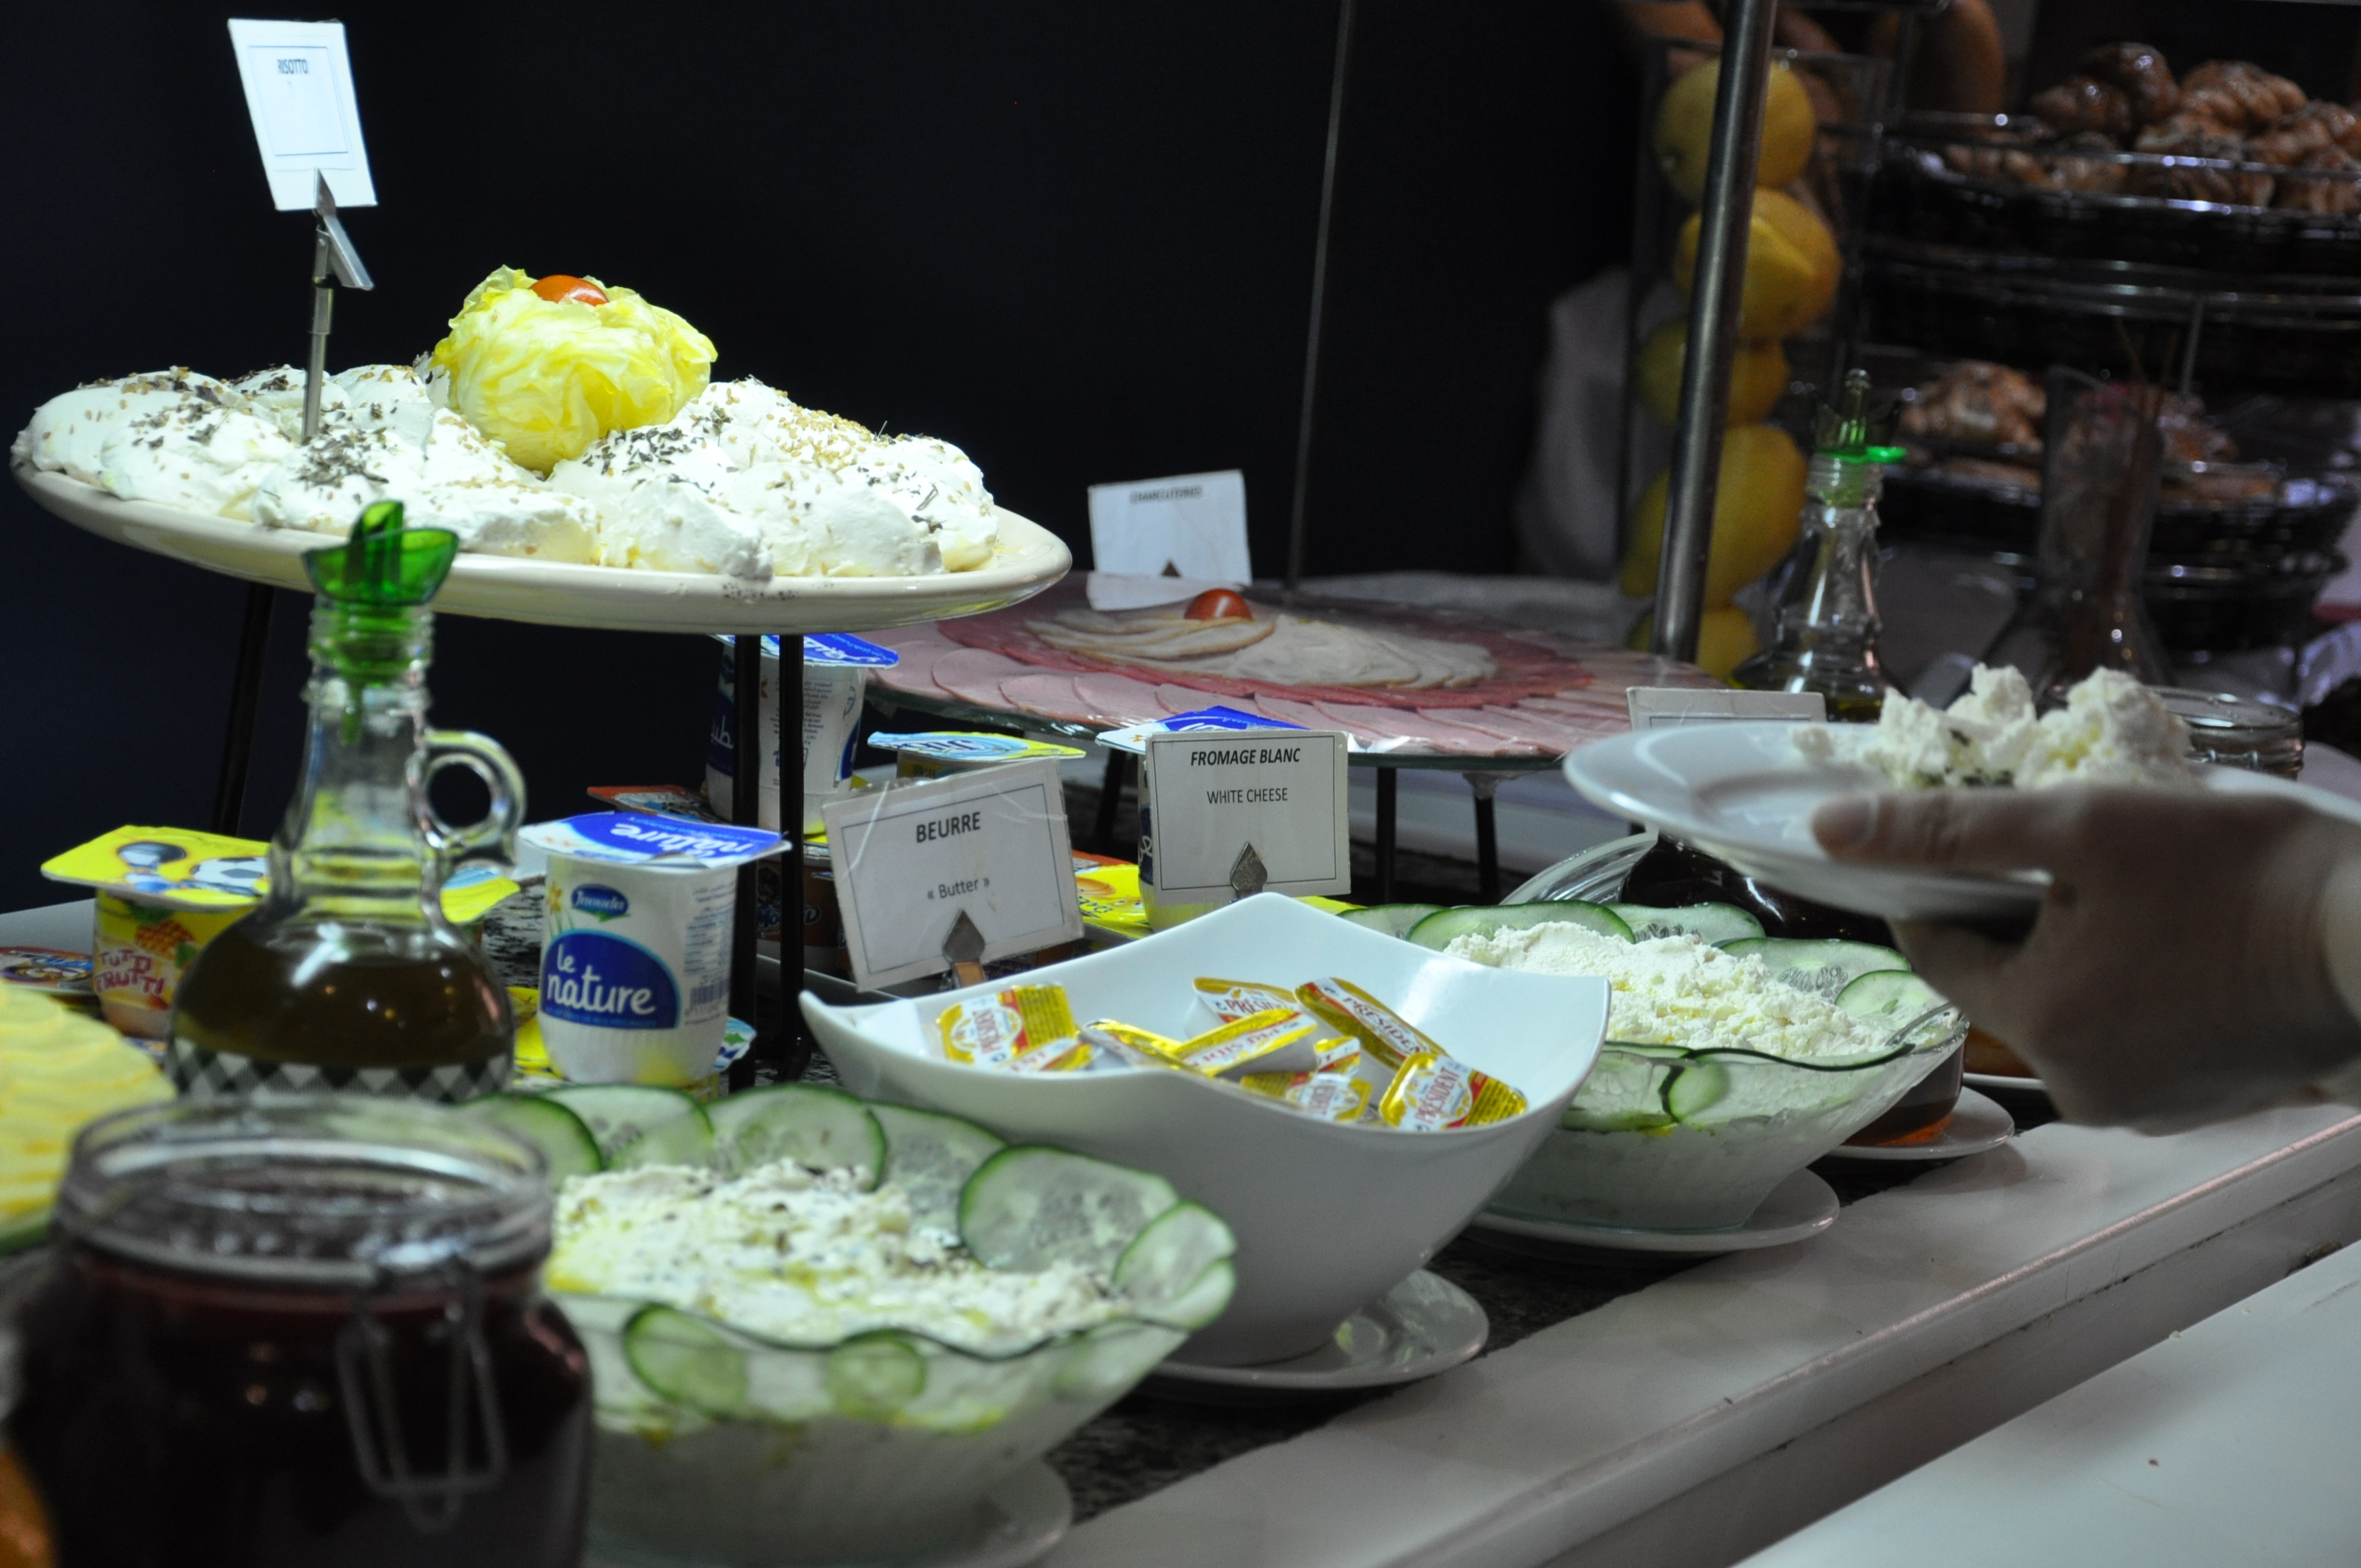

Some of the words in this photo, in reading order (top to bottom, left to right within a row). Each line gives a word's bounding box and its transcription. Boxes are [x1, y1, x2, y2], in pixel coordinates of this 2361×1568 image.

[277, 59, 308, 74] RISOTTO
[1191, 749, 1256, 766] FROMAGE
[1259, 748, 1301, 763] BLANC
[1207, 789, 1243, 805] WHITE
[1247, 788, 1288, 803] CHEESE
[916, 811, 981, 843] BEURRE
[939, 880, 979, 899] Butter
[556, 944, 575, 973] le
[547, 965, 657, 1015] nature
